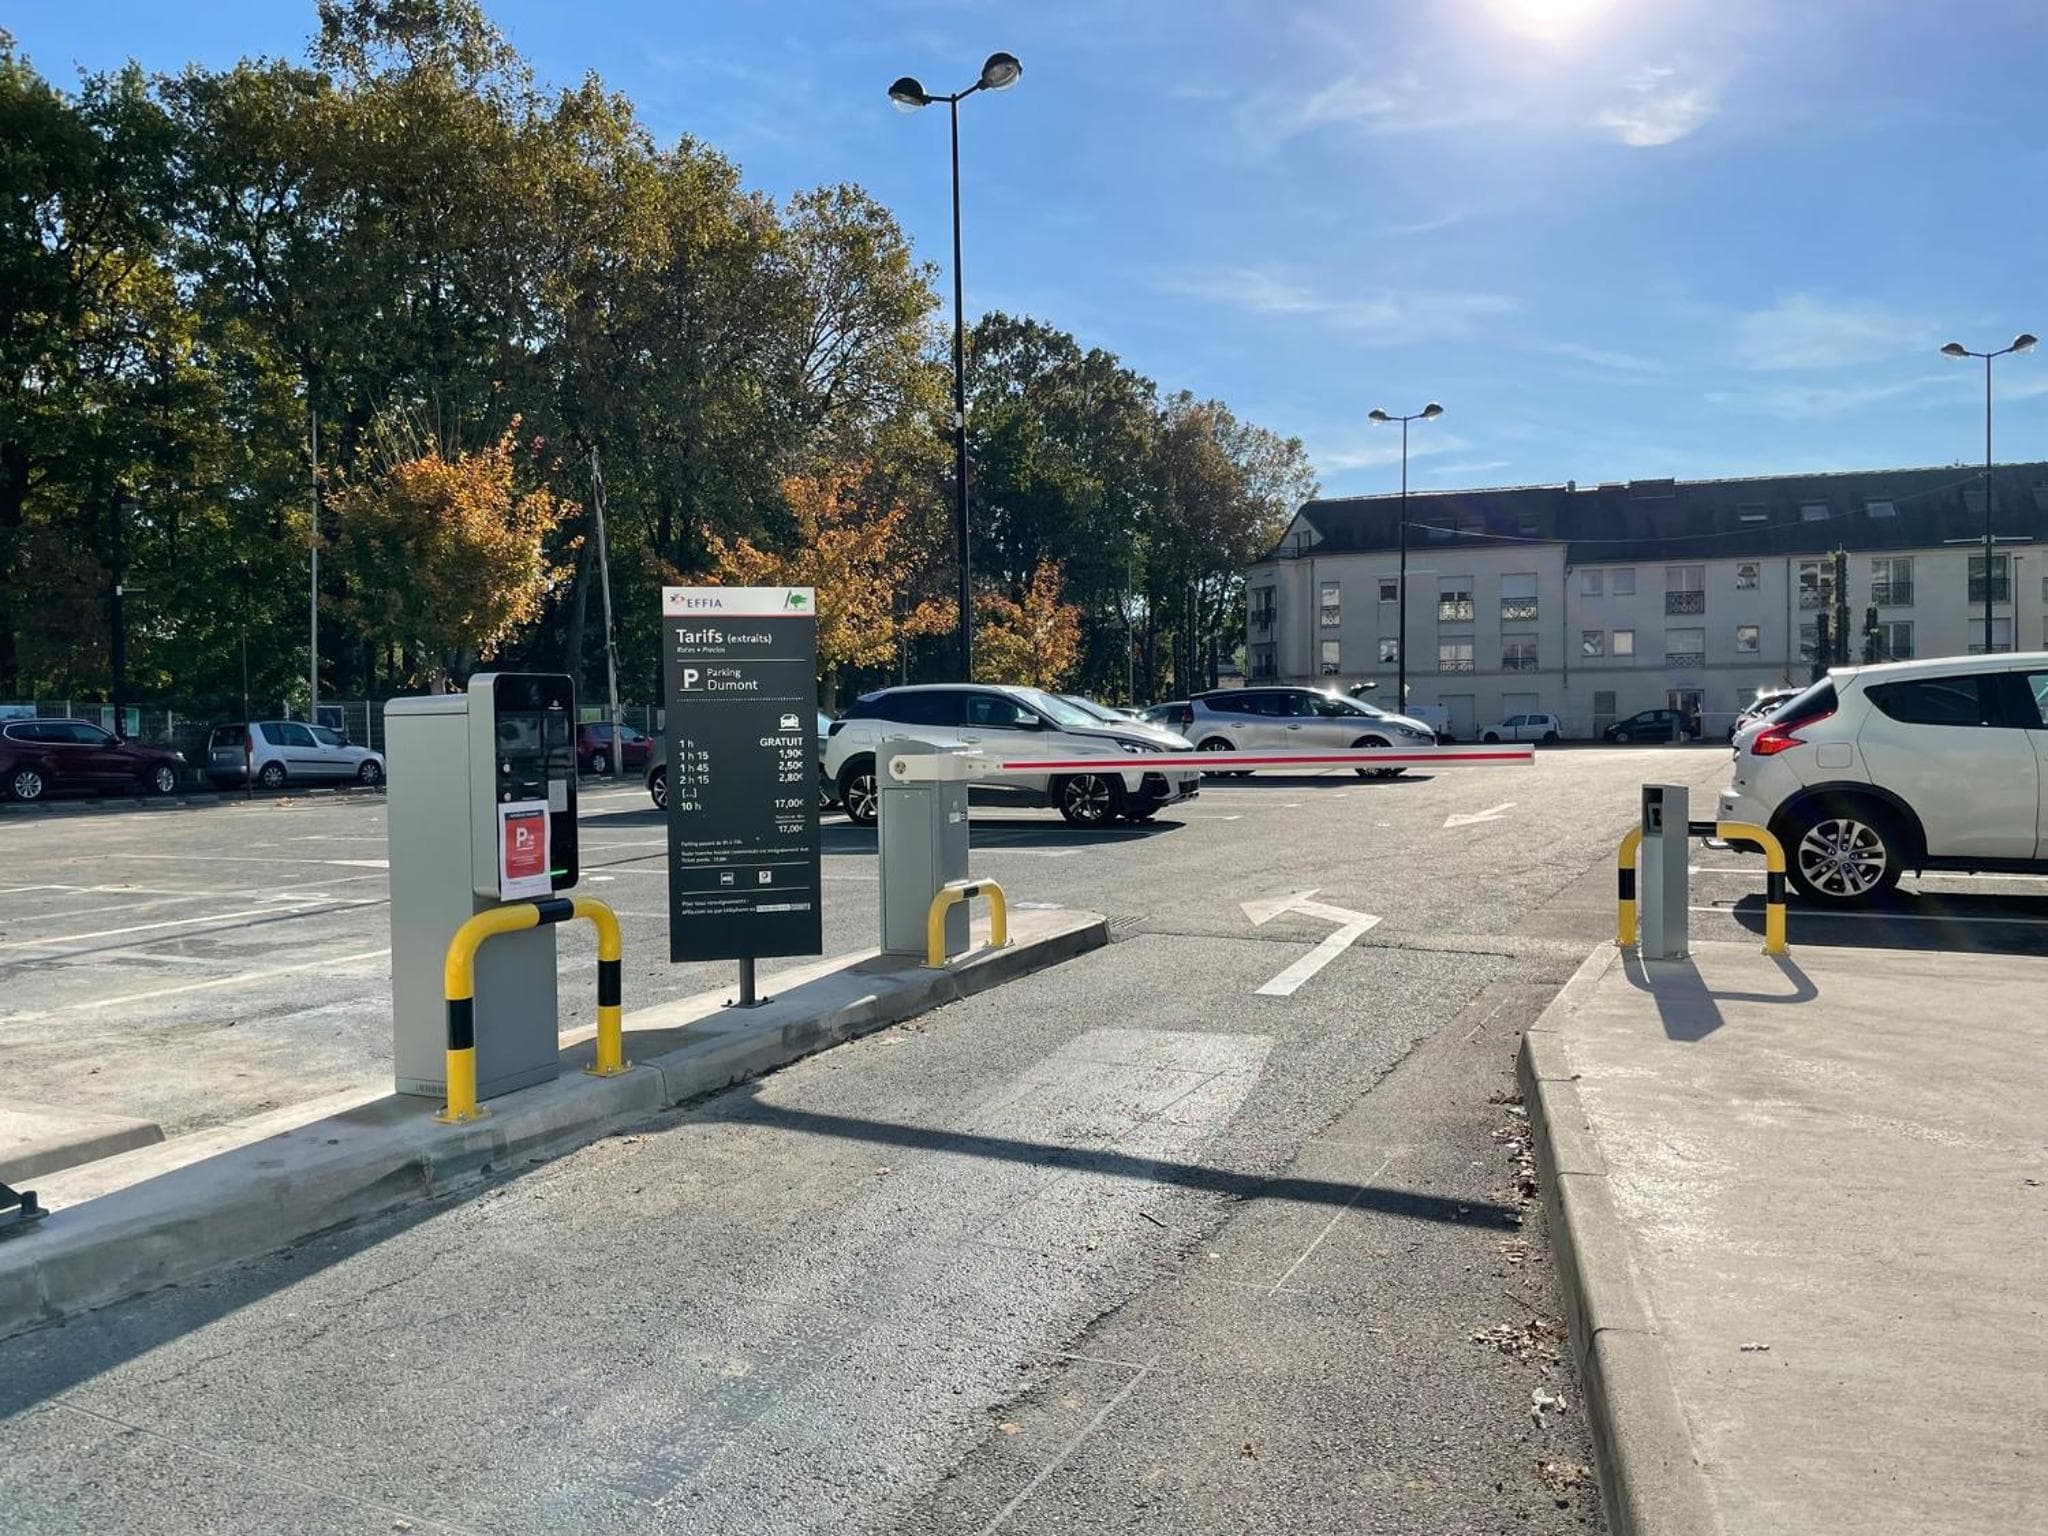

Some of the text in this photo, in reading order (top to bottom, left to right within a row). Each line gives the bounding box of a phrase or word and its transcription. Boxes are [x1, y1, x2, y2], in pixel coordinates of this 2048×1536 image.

[687, 599, 722, 608] EFFIA
[676, 629, 772, 644] Tarifs (extraits)
[706, 668, 742, 678] Parking
[683, 668, 699, 688] P
[708, 680, 758, 690] Dumont
[680, 740, 694, 748] 1 h
[760, 738, 804, 747] GRATUIT
[680, 752, 709, 760] 1 h 15
[680, 764, 710, 772] 1 h 45
[680, 776, 710, 784] 2 h 15
[681, 802, 702, 810] 10 h
[516, 827, 528, 848] P
